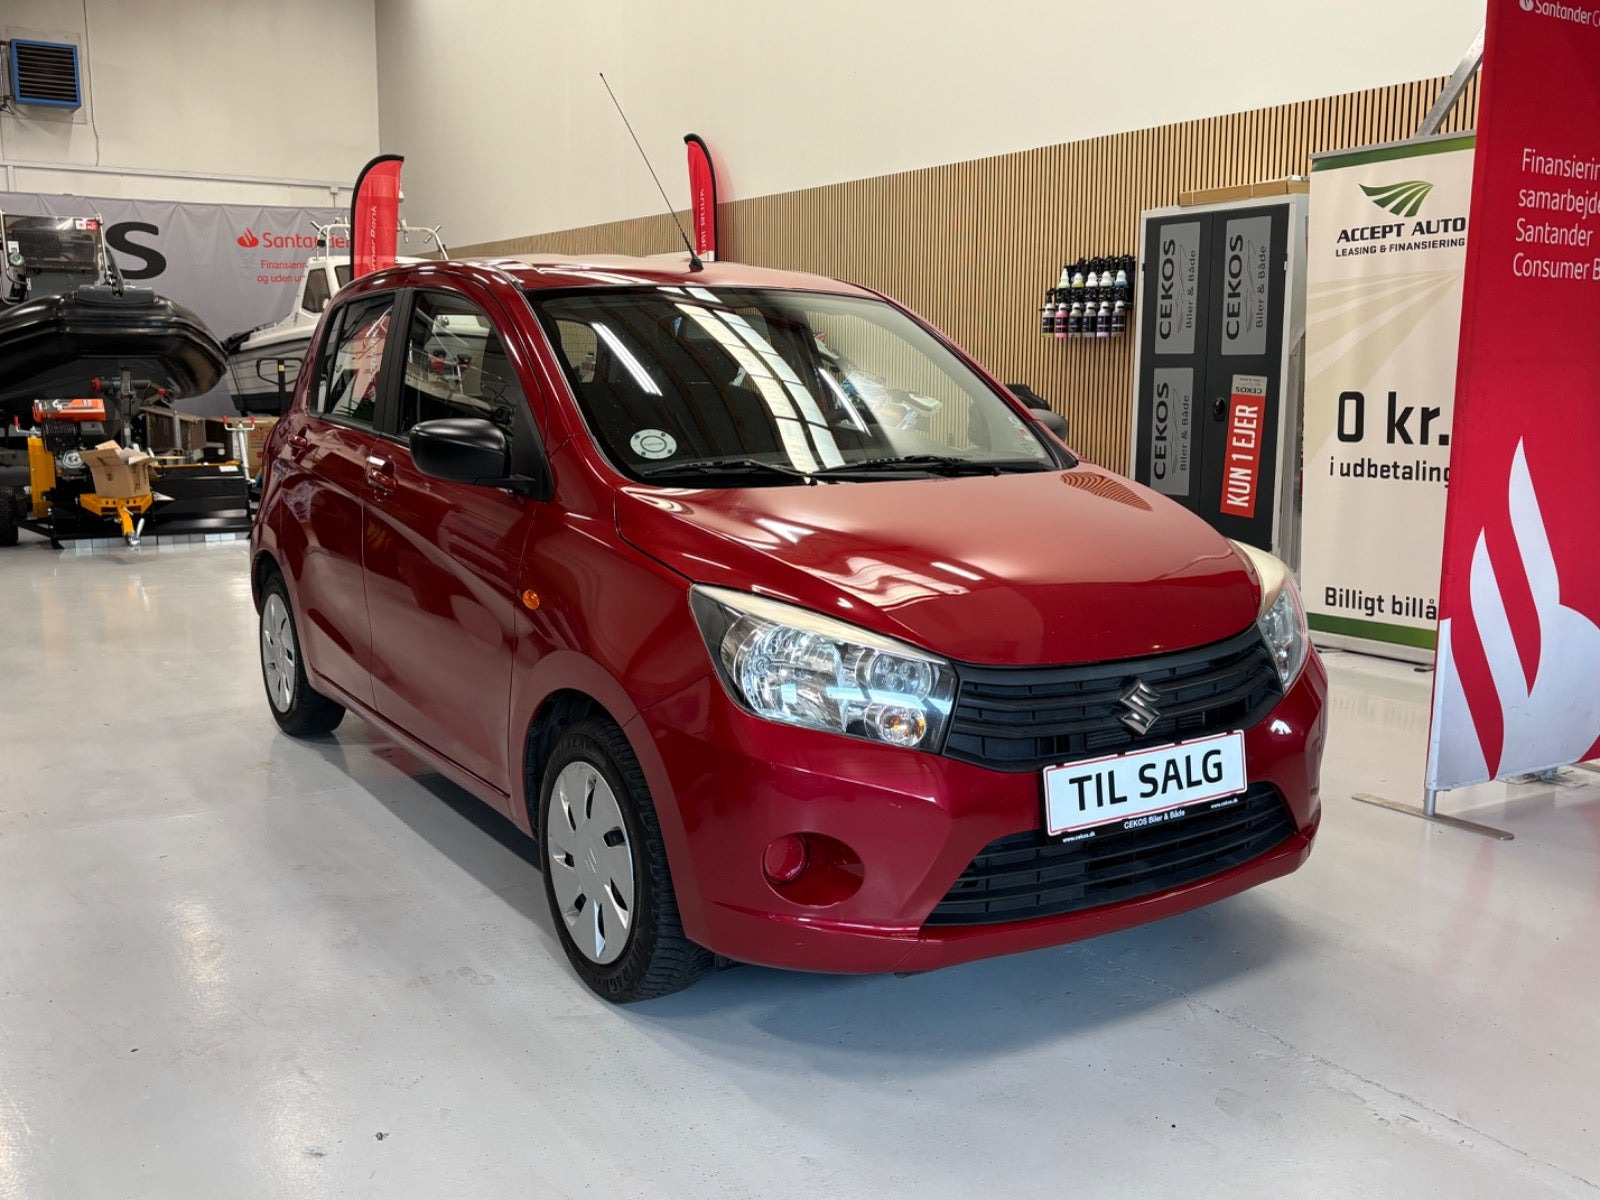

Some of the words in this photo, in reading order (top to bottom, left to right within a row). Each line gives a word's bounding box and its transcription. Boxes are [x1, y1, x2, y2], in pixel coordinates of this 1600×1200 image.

[1535, 0, 1592, 25] Santander
[1336, 223, 1405, 244] ACCEPT
[1411, 217, 1466, 236] AUTO
[1515, 217, 1594, 247] Santander
[1335, 245, 1377, 257] LEASING
[1379, 244, 1387, 253] &
[1389, 237, 1465, 252] FINANSIERING
[1188, 250, 1196, 282] Både
[1258, 245, 1266, 280] Både
[1513, 252, 1590, 281] Consumer
[1159, 238, 1176, 340] CEKOS
[1187, 286, 1194, 296] &
[1226, 234, 1243, 340] CEKOS
[1257, 284, 1265, 295] &
[1185, 301, 1194, 328] Biler
[1256, 298, 1266, 328] Biler
[1181, 395, 1190, 426] Både
[1337, 391, 1365, 443] 0
[1386, 391, 1450, 446] kr.
[1154, 382, 1170, 480] CEKOS
[1181, 431, 1189, 440] &
[1232, 404, 1259, 449] EJER
[1180, 444, 1189, 471] Biler
[1231, 453, 1254, 461] 1
[1329, 455, 1334, 476] i
[1226, 467, 1253, 507] KUN
[1325, 586, 1385, 617] Billigt
[1391, 595, 1437, 621] billå
[1068, 769, 1128, 812] TIL
[1138, 749, 1223, 799] SALG
[1123, 818, 1148, 830] CEKOS
[1149, 813, 1163, 825] Biler
[1163, 812, 1169, 821] &
[1170, 808, 1186, 819] Både
